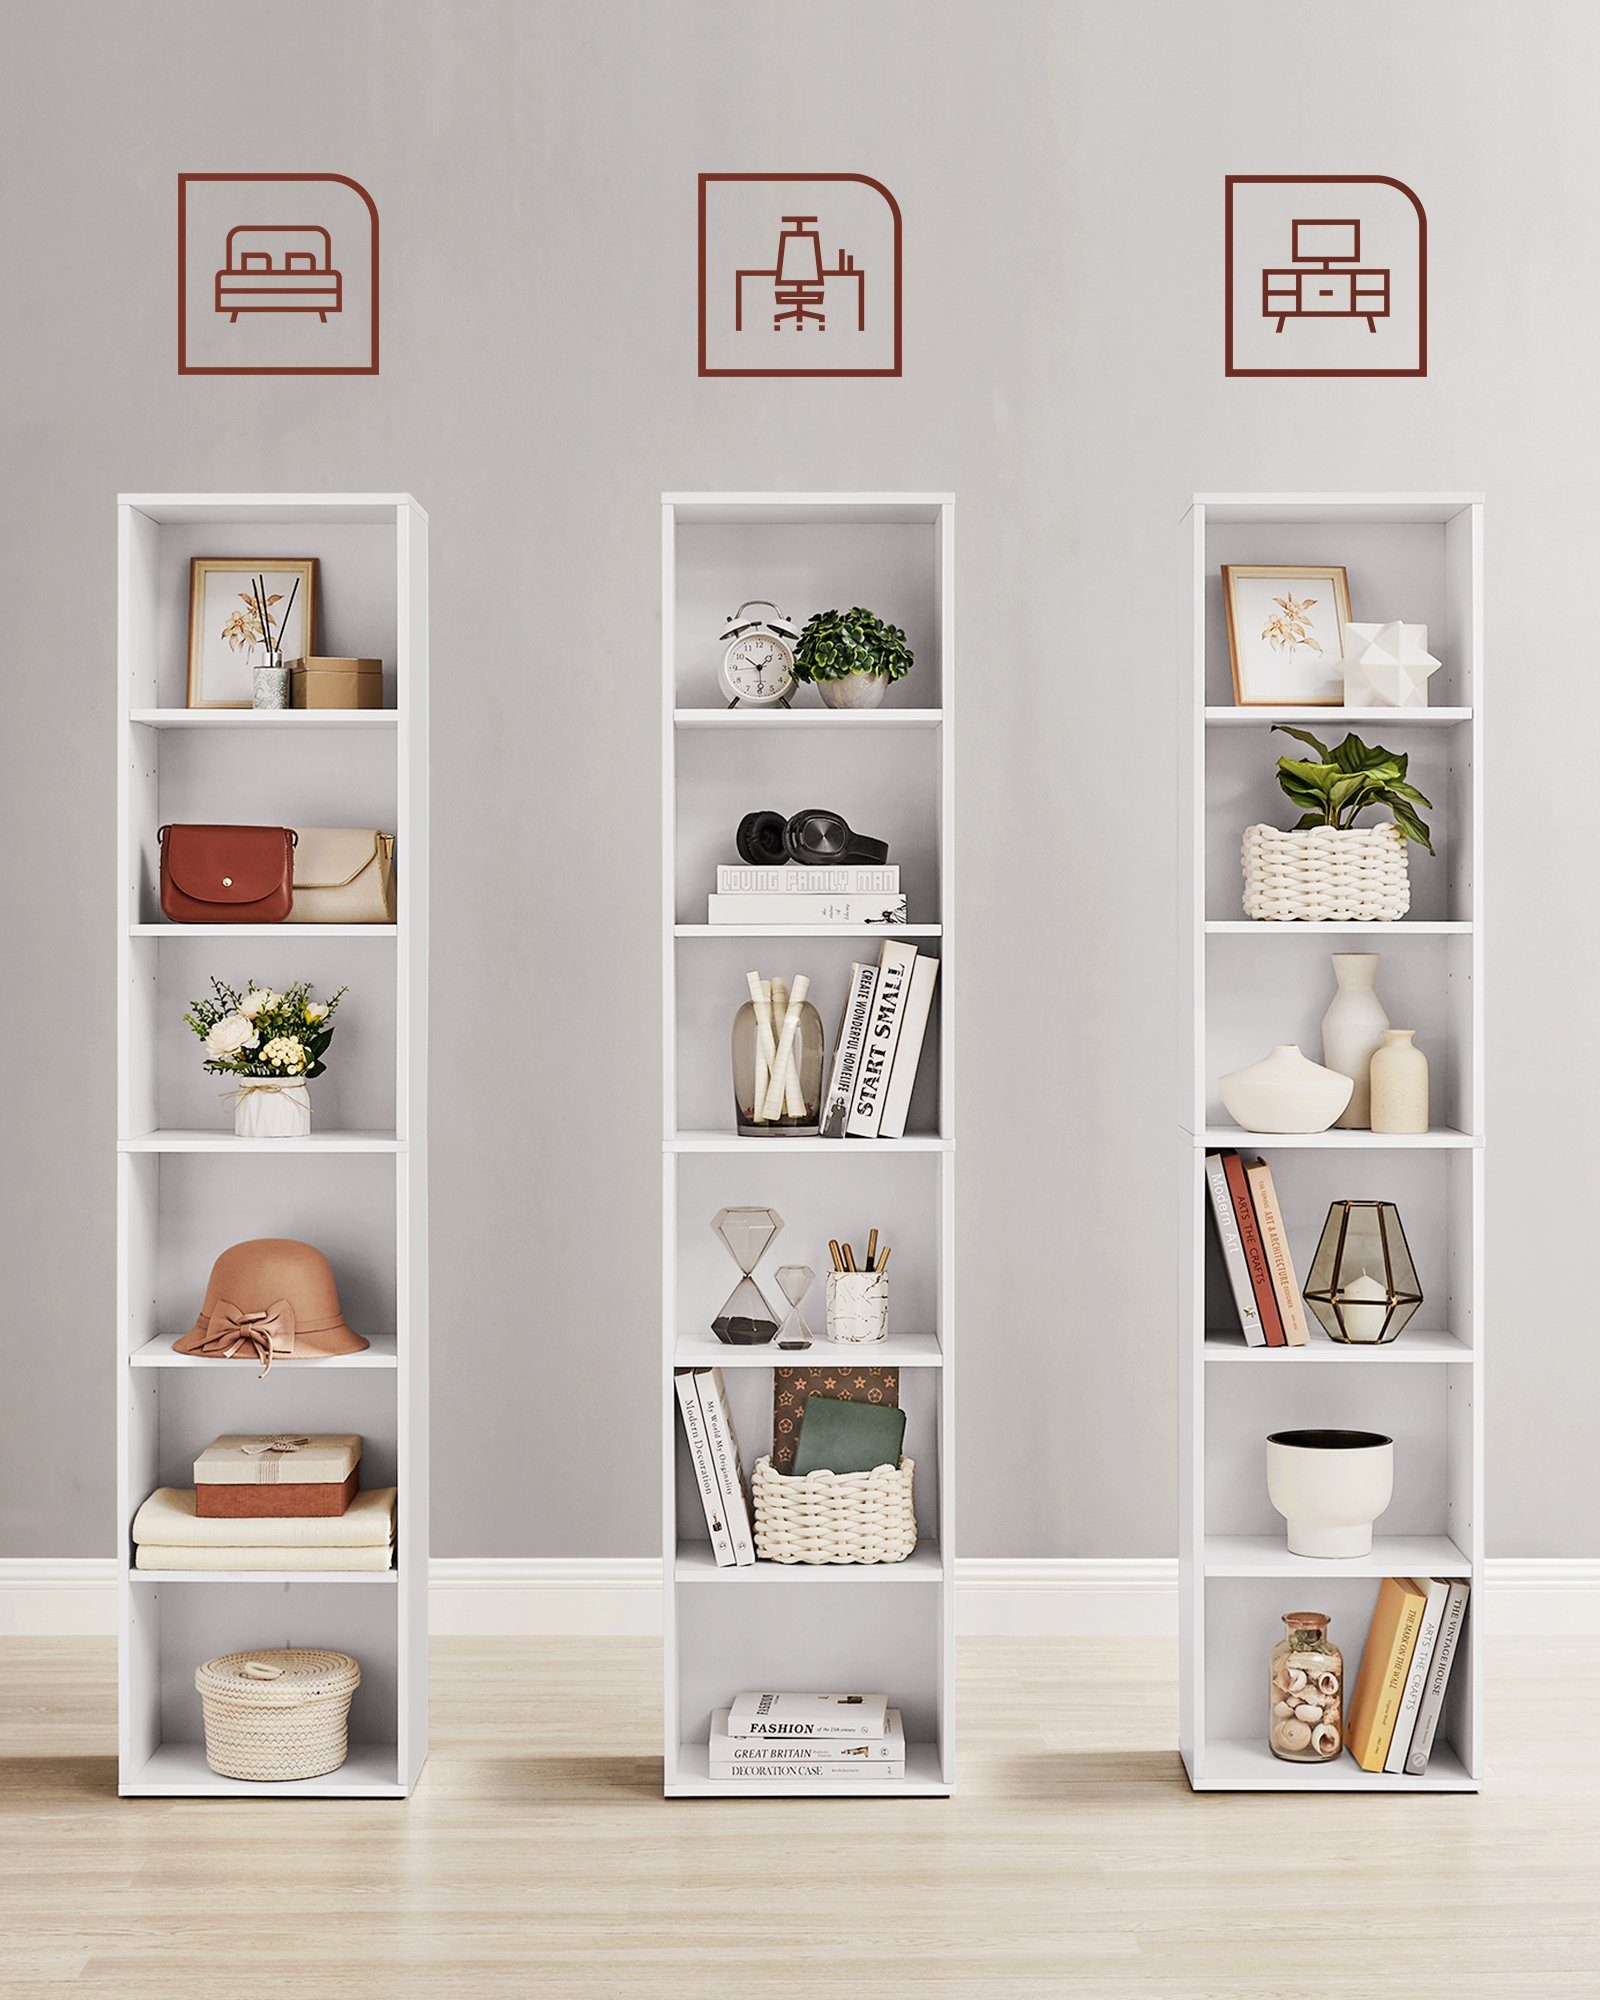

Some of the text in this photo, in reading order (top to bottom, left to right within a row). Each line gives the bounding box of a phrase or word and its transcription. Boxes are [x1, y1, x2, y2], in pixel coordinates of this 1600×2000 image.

[744, 644, 752, 652] 11
[755, 641, 764, 649] 12
[770, 644, 773, 652] 1
[736, 652, 745, 660] 10
[777, 653, 783, 661] 2
[781, 664, 788, 672] 3
[745, 684, 751, 692] 7
[769, 684, 775, 692] 5
[722, 870, 895, 892] LOVING FAMILY MAN
[837, 969, 874, 1093] CREATE WONDERFUL HOMELIFE
[856, 962, 906, 1118] START SMALL
[1211, 1173, 1240, 1253] Modern Art
[1264, 1211, 1275, 1224] ART
[1236, 1195, 1265, 1285] ARTS THE CRAFTS
[1269, 1232, 1290, 1286] ARCHITECTURE
[685, 1399, 712, 1496] Modern Decoration
[707, 1400, 733, 1496] My World My Originality
[1389, 1609, 1417, 1690] THE MARK ON THE WALL
[1431, 1599, 1463, 1696] THE VINTAGE HOUSE
[1405, 1621, 1435, 1711] ARTS THE CRAFTS
[750, 1723, 815, 1734] FASHION
[734, 1749, 769, 1759] GREAT
[770, 1749, 812, 1759] BRITAIN
[731, 1766, 798, 1776] DECORATION
[798, 1766, 824, 1776] CASE
